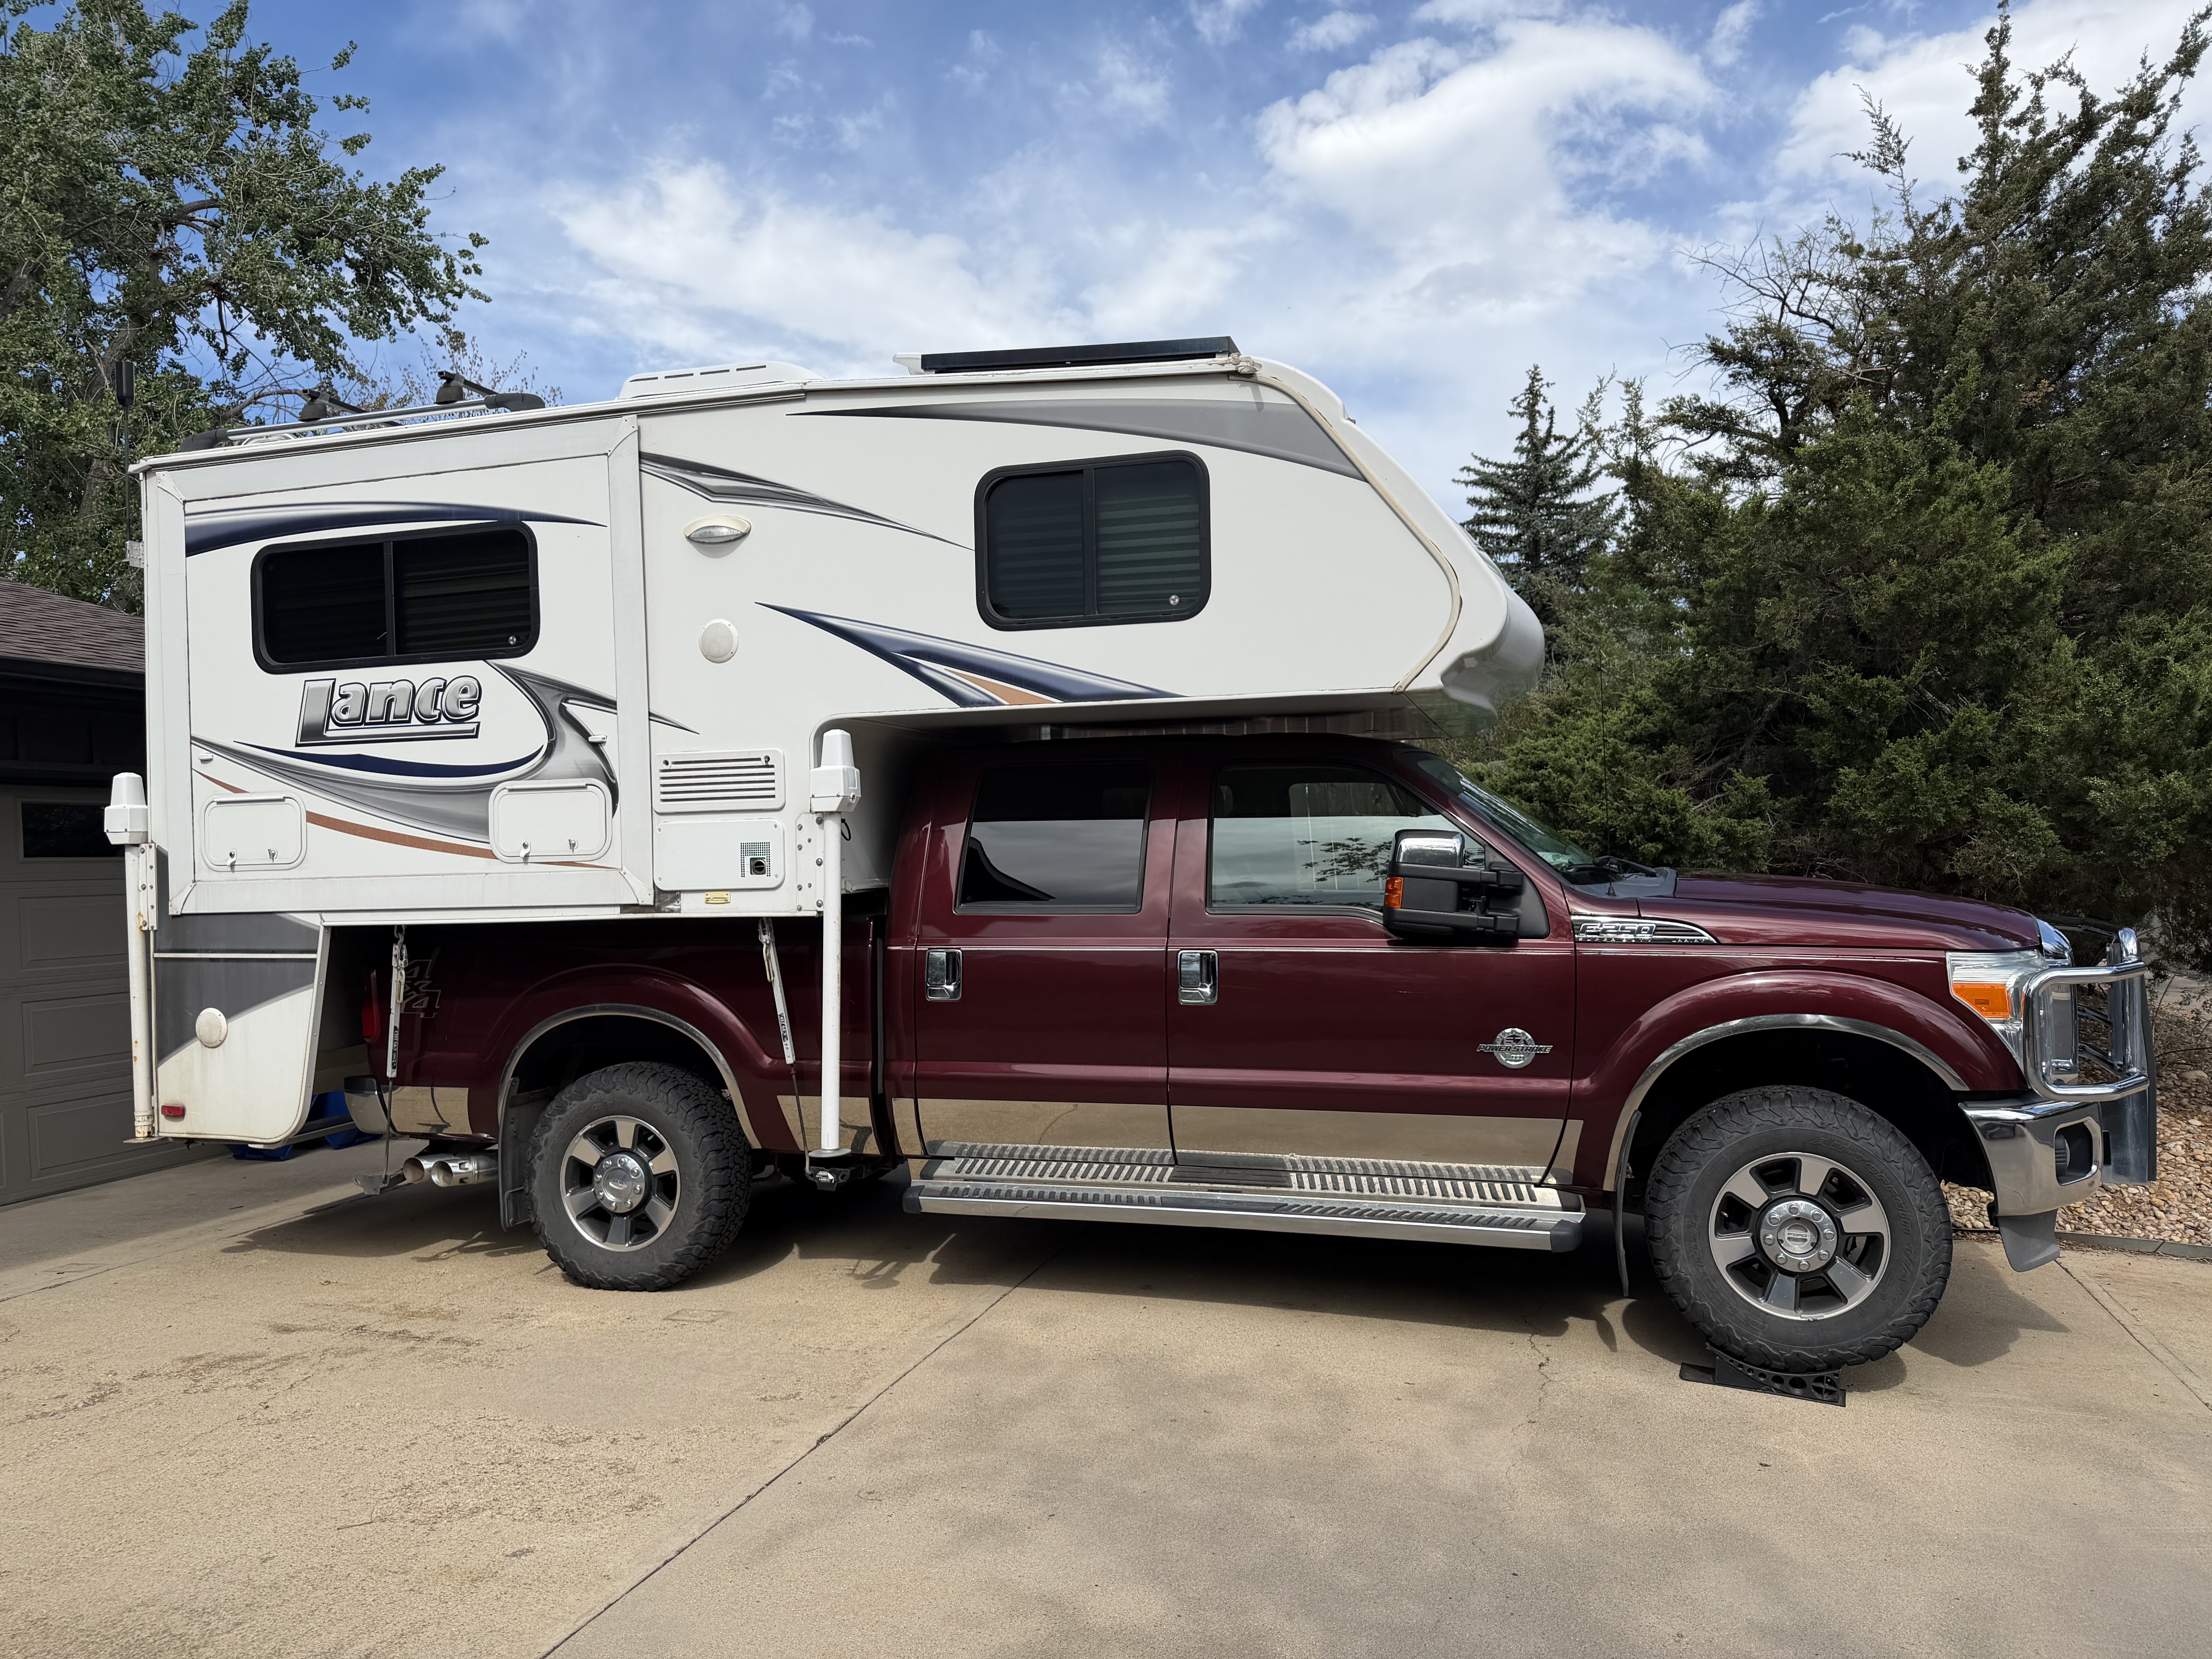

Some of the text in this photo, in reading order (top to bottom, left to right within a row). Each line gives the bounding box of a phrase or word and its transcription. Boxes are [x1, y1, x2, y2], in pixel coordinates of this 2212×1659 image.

[295, 674, 482, 747] Lance
[1477, 1044, 1553, 1053] POWER STROKE
